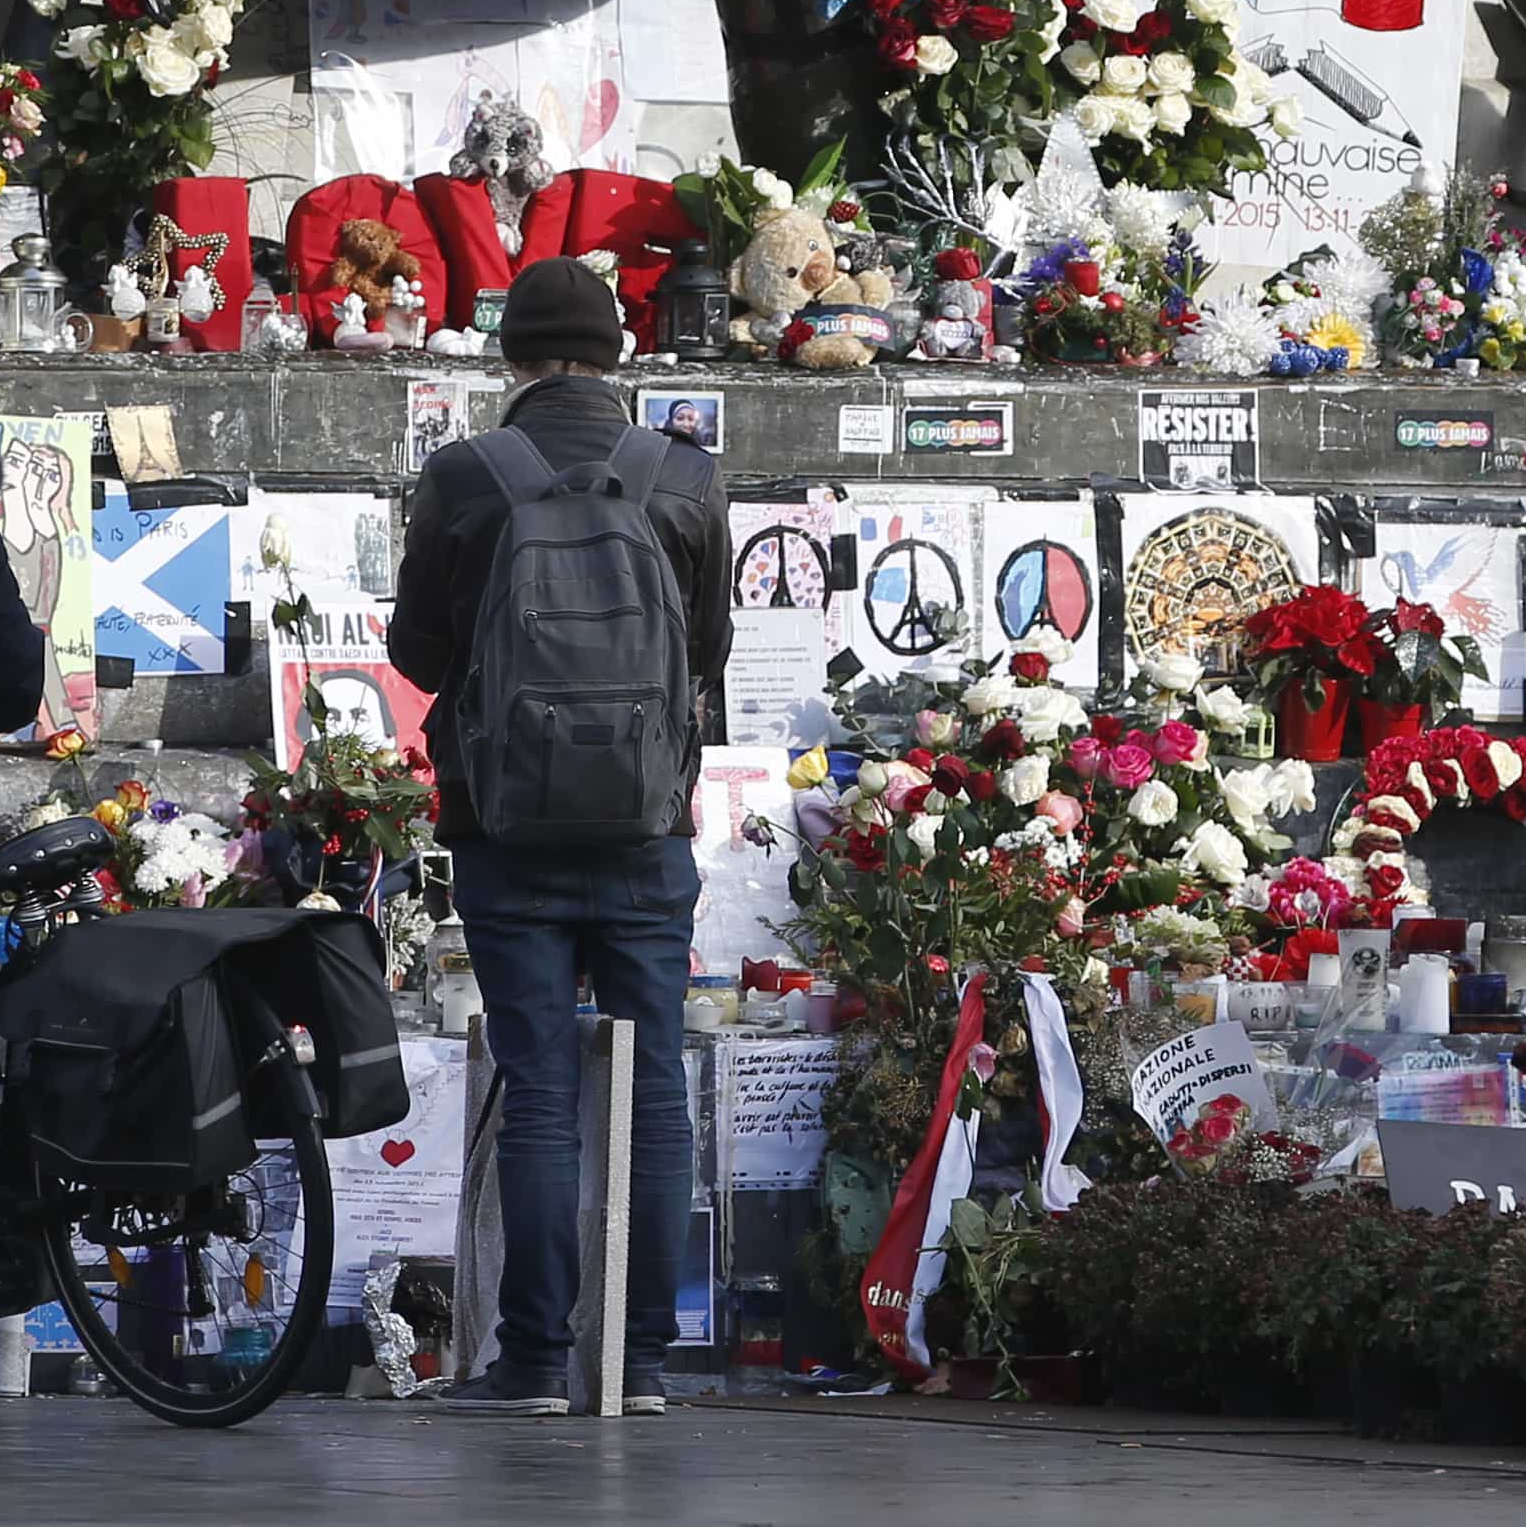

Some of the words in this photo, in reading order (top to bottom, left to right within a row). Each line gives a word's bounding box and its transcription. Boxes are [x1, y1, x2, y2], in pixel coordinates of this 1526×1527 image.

[910, 425, 927, 443] 17
[928, 424, 959, 442] PLUS
[959, 423, 1001, 442] JAMAIS
[1400, 426, 1416, 442] 17
[1417, 426, 1447, 442] PLUS
[1447, 426, 1489, 442] JAMAIS
[134, 511, 189, 541] PARIS
[342, 612, 370, 646] AL
[1250, 1006, 1282, 1022] RIP
